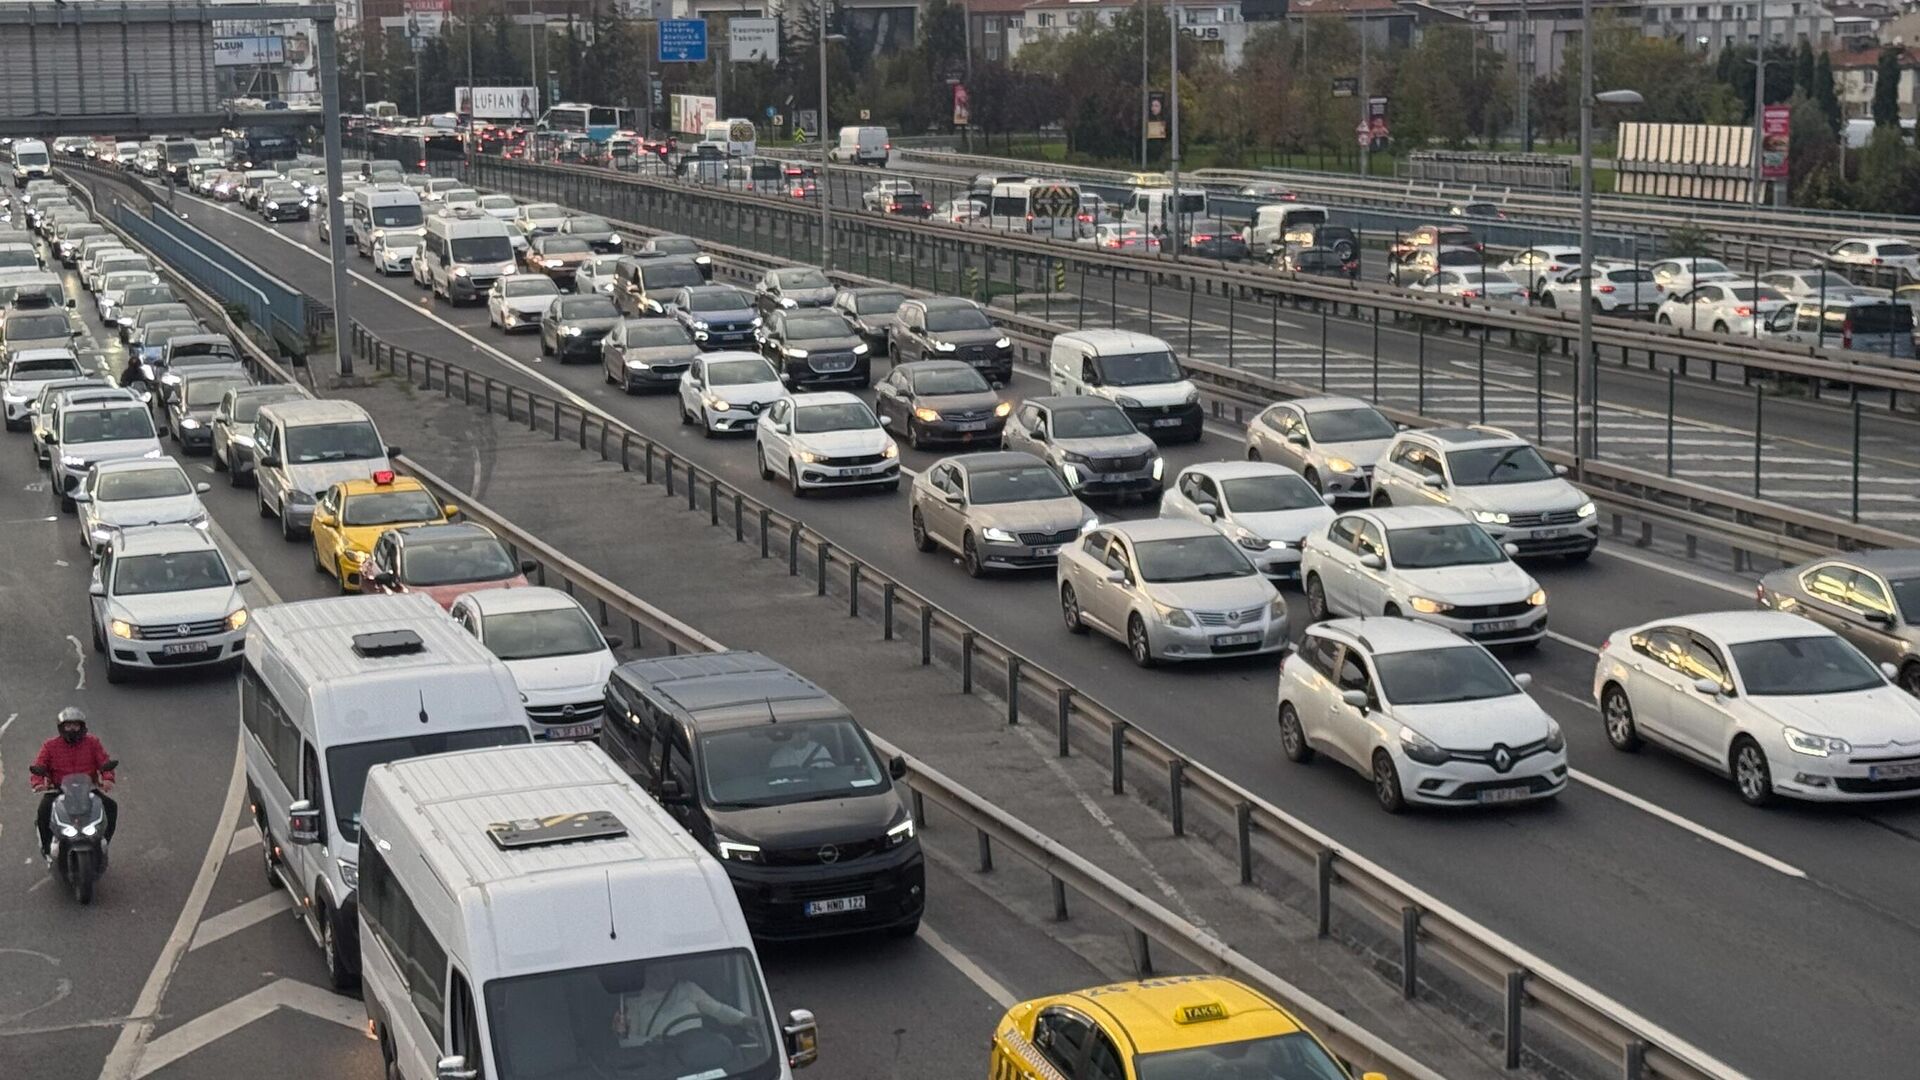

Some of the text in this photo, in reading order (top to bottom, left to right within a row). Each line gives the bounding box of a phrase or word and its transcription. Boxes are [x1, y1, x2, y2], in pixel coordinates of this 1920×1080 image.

[474, 94, 514, 109] LUFIAN
[811, 903, 822, 913] 34
[848, 898, 864, 908] 122
